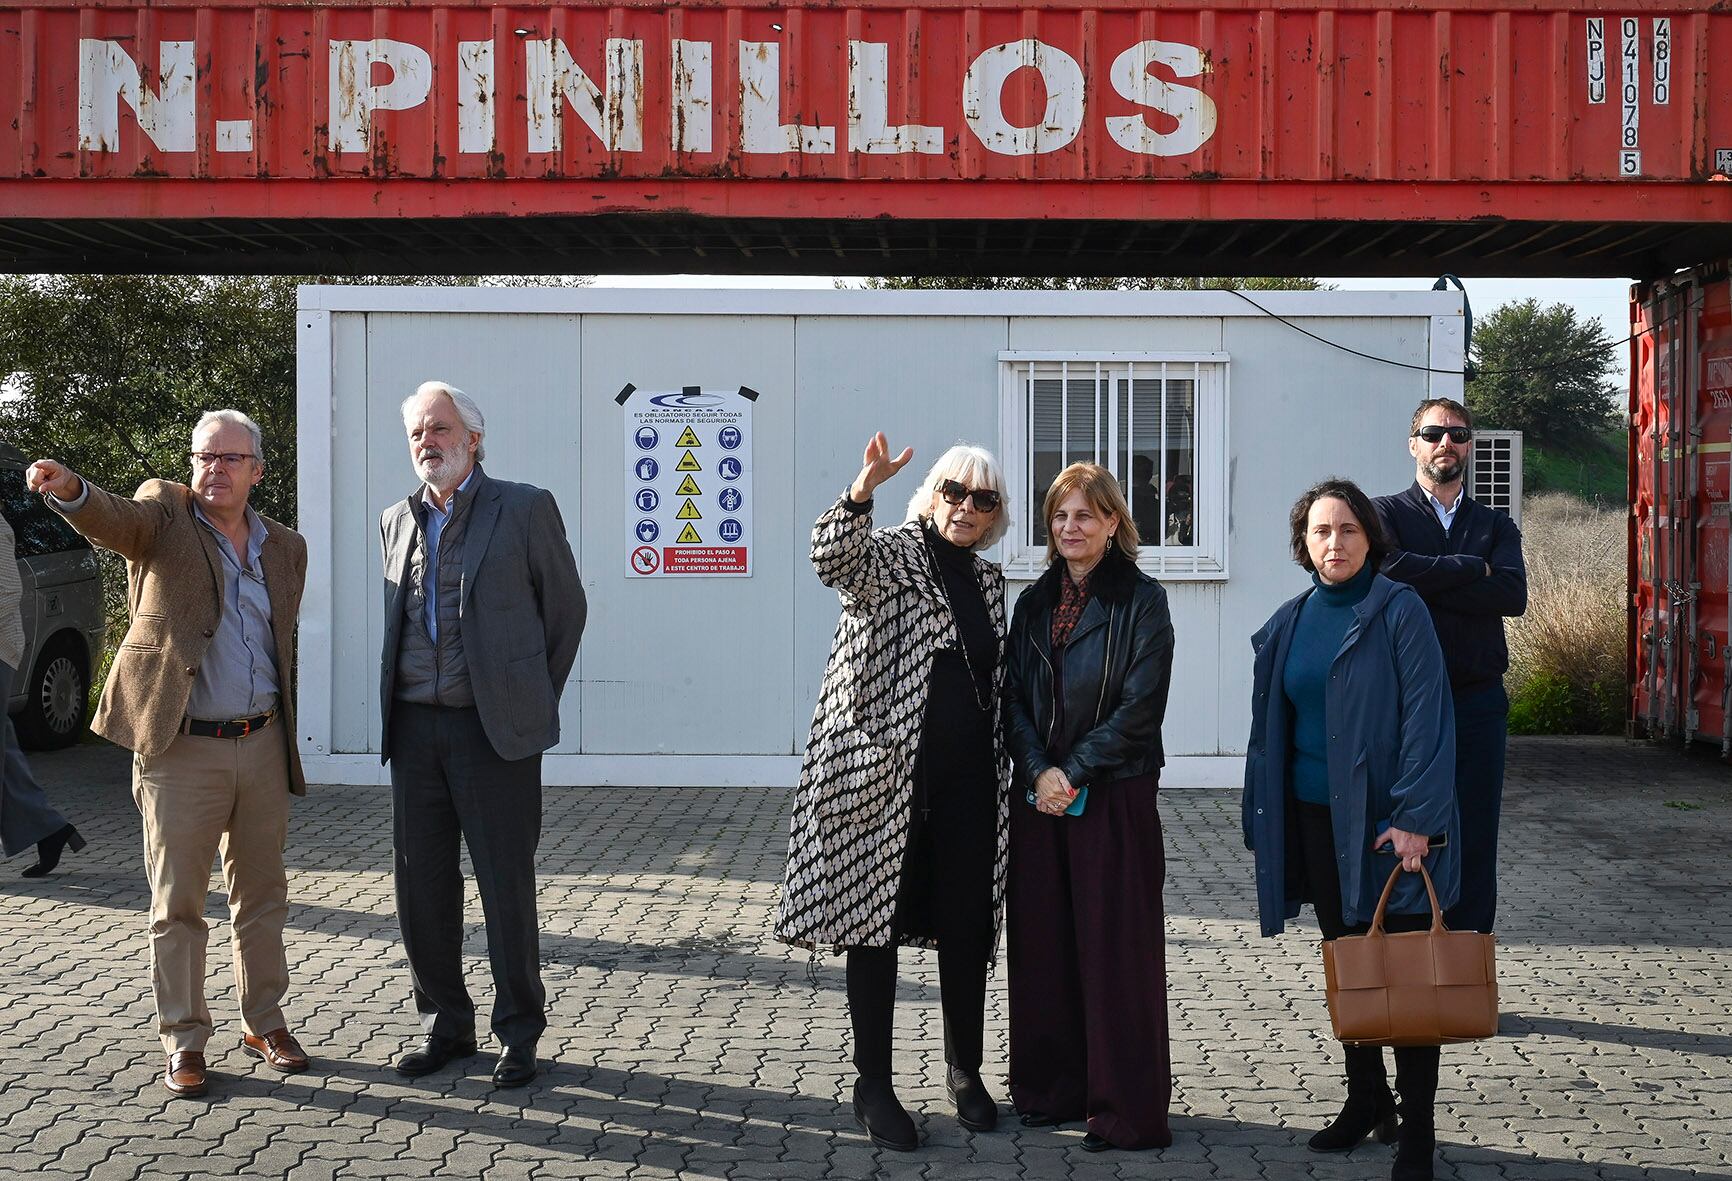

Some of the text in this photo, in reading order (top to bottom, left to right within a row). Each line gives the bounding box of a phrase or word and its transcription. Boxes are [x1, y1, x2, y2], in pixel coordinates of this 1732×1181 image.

[79, 38, 1218, 156] N. PINILLOS
[1587, 19, 1604, 103] NPJU
[1655, 19, 1668, 103] 48U0
